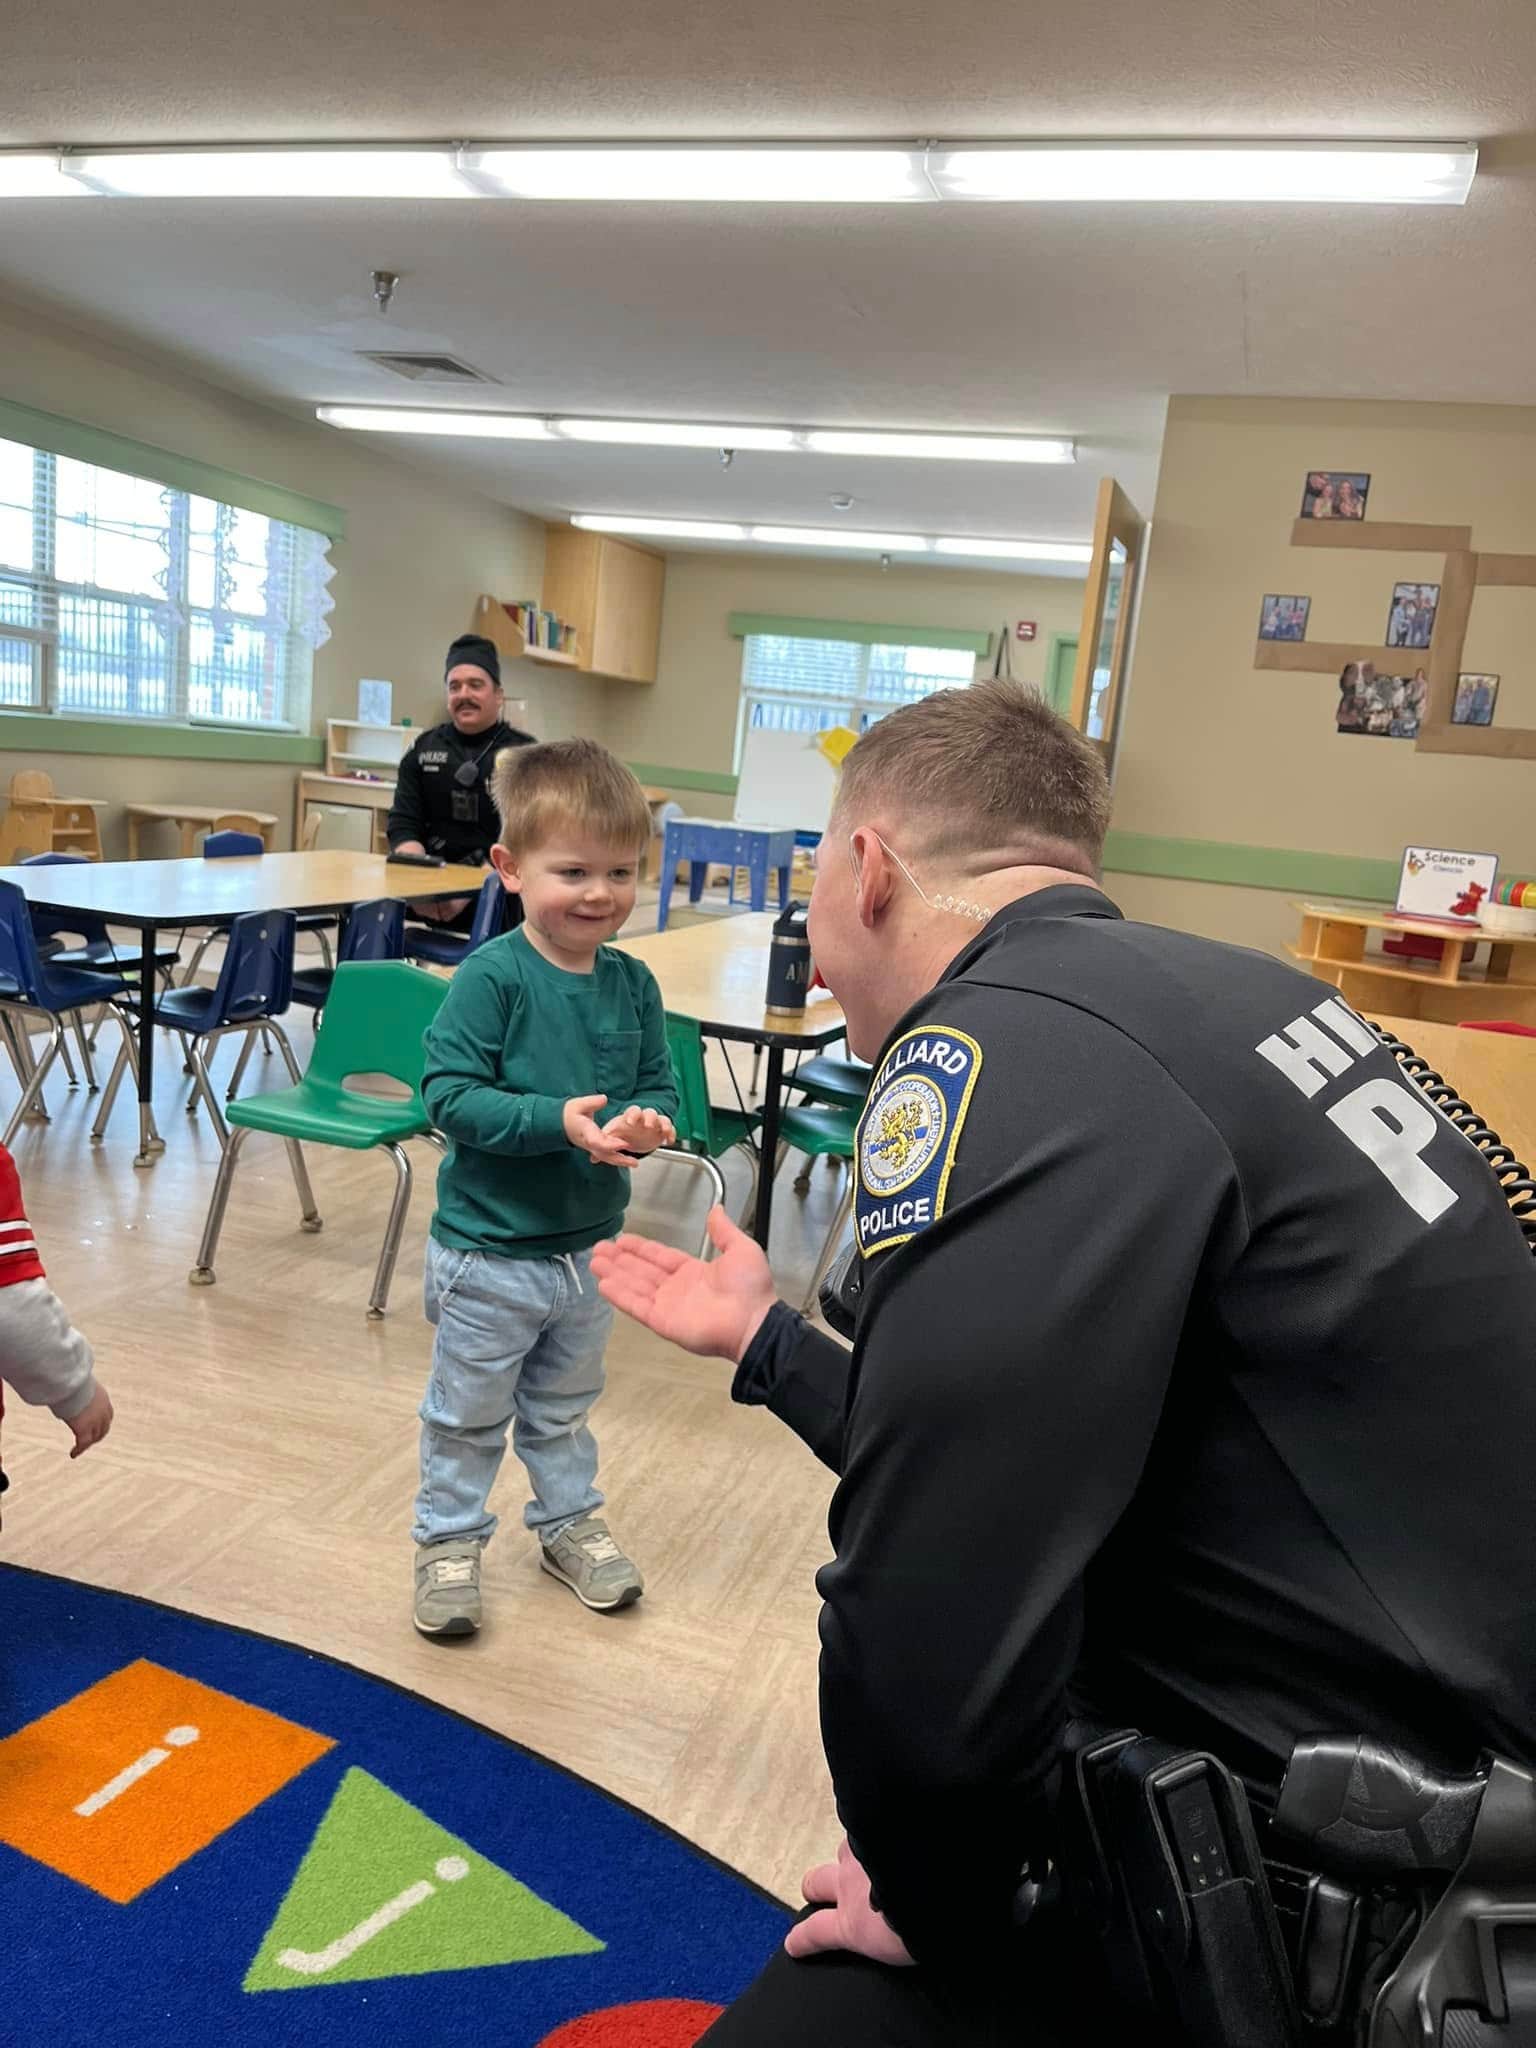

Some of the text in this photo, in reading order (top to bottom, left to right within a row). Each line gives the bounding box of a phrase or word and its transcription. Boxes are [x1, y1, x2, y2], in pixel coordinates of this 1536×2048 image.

[1425, 850, 1476, 866] Science
[870, 1040, 968, 1105] HILLIARD
[1255, 996, 1384, 1099] HI
[860, 1197, 930, 1240] POLICE
[73, 1725, 200, 1817] i
[275, 1856, 470, 1975] j
